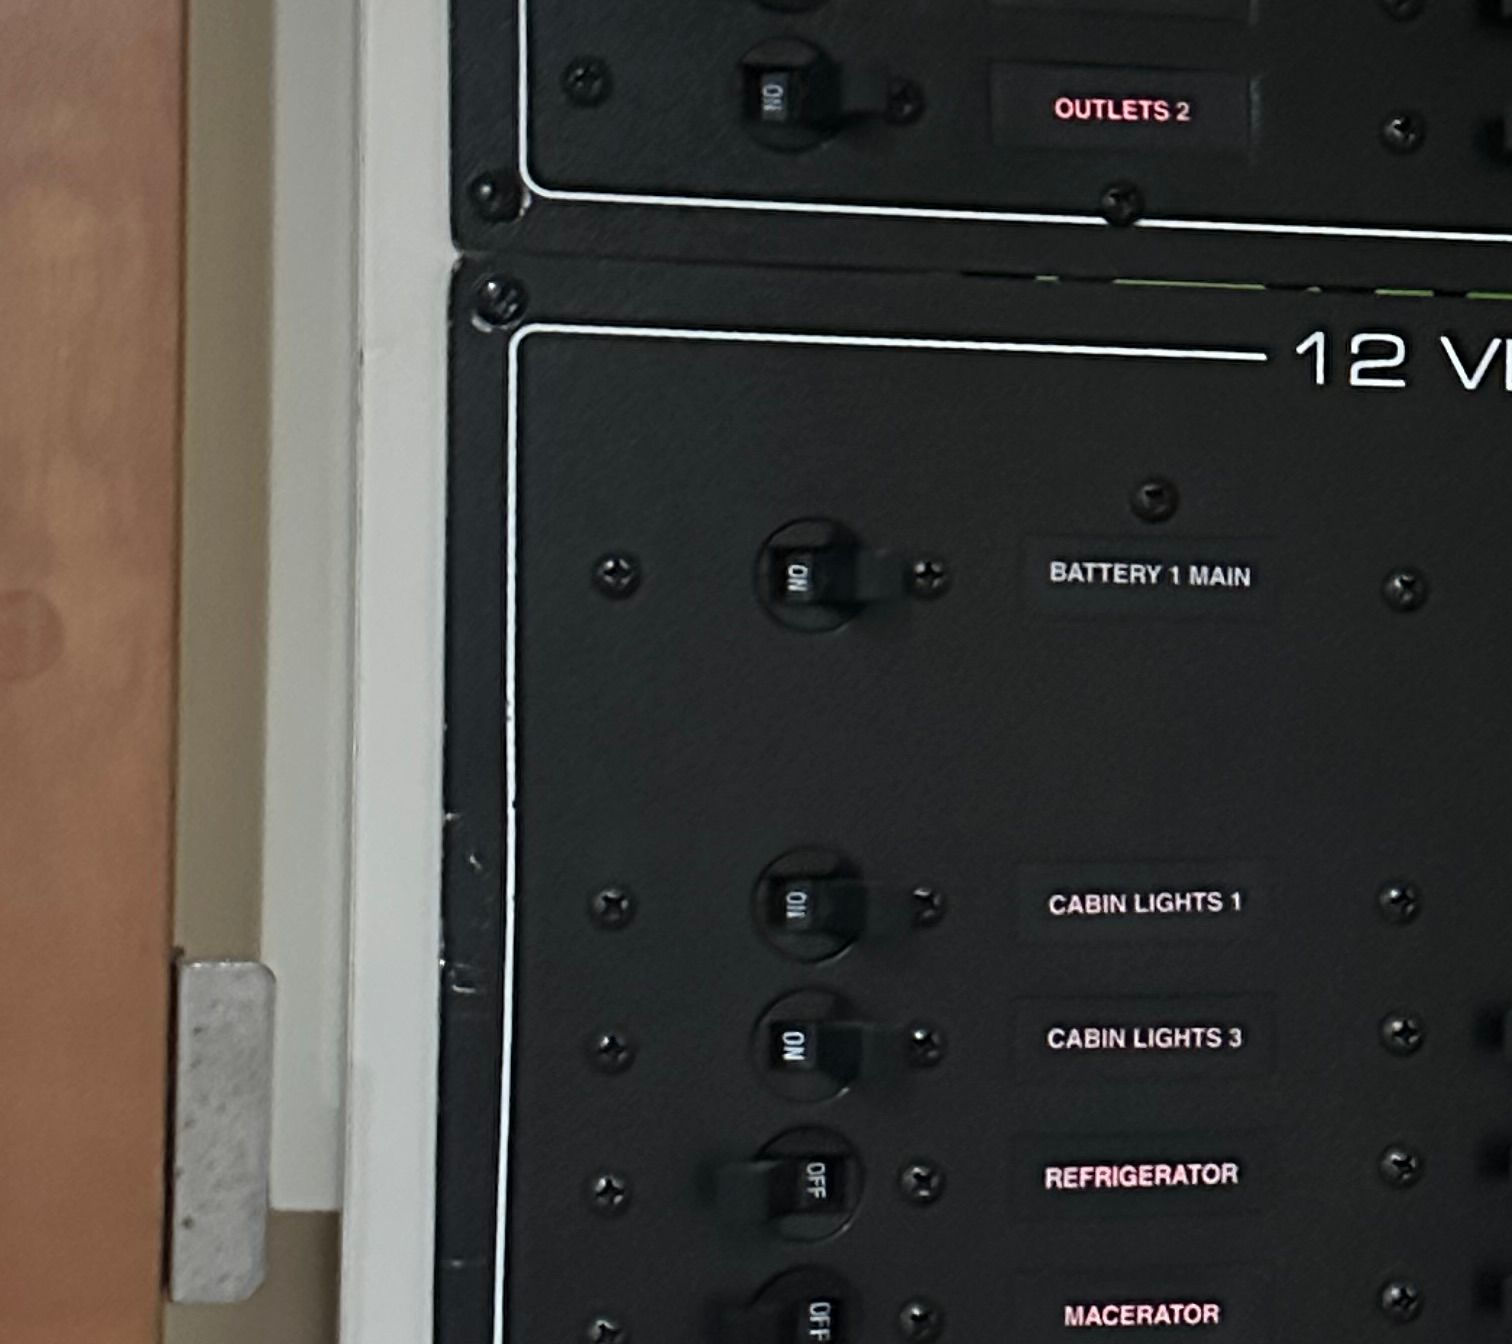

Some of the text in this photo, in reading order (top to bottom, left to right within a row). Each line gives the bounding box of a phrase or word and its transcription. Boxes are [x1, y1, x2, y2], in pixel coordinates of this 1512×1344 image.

[1054, 97, 1190, 122] OUTLETS 2
[1295, 331, 1406, 388] 12
[787, 564, 809, 592] ON
[1049, 560, 1251, 587] BATTERY 1 MAIN
[1048, 891, 1241, 916] CABIN LIGHTS 1
[782, 1031, 805, 1061] ON
[1047, 1027, 1242, 1049] CABIN LIGHTS 3
[806, 1162, 827, 1199] OFF
[1045, 1162, 1239, 1190] REFRIGERATOR
[809, 1302, 831, 1342] OFF
[1064, 1302, 1220, 1327] MACERATOR
